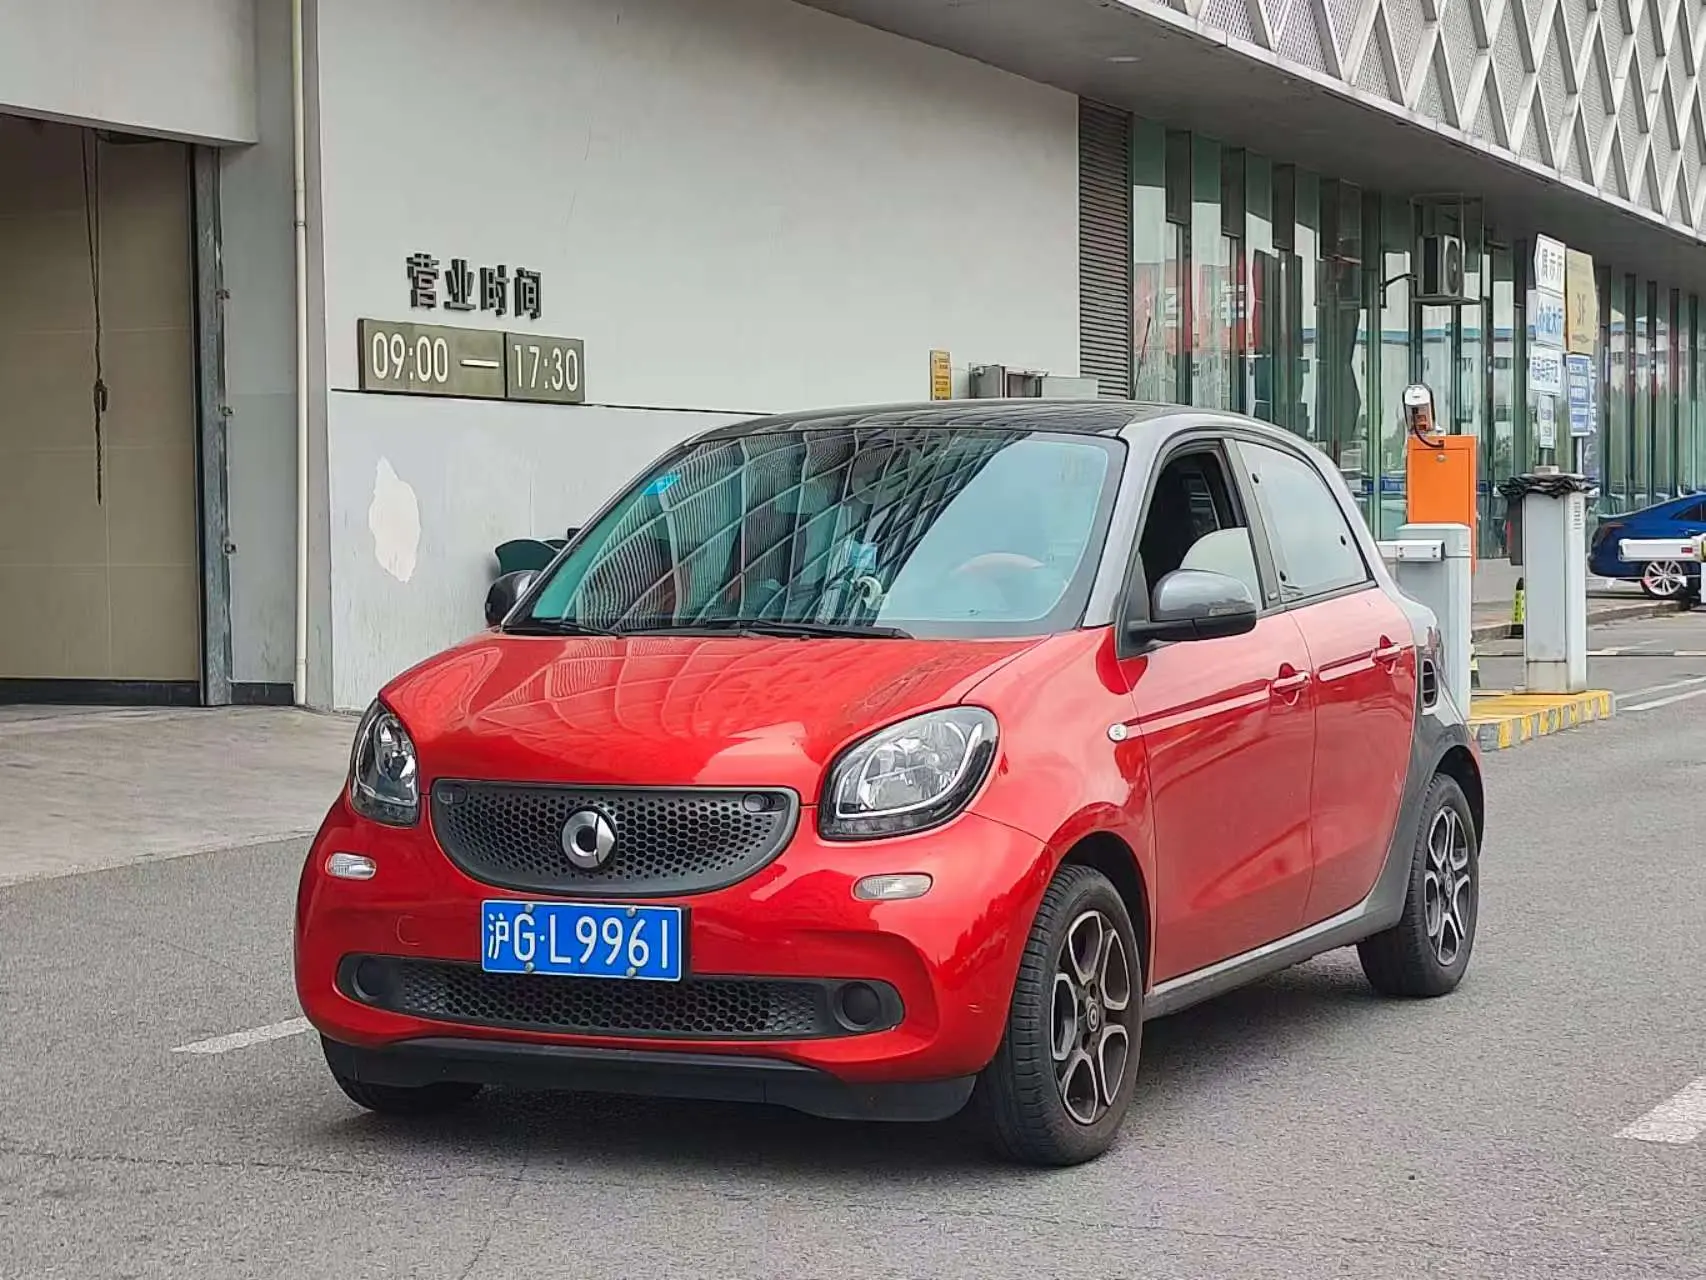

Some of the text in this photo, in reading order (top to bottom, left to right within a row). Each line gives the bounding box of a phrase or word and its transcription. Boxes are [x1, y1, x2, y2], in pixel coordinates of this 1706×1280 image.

[406, 253, 543, 320] 营业时间
[372, 331, 448, 383] 09:00
[514, 344, 579, 392] 17:30
